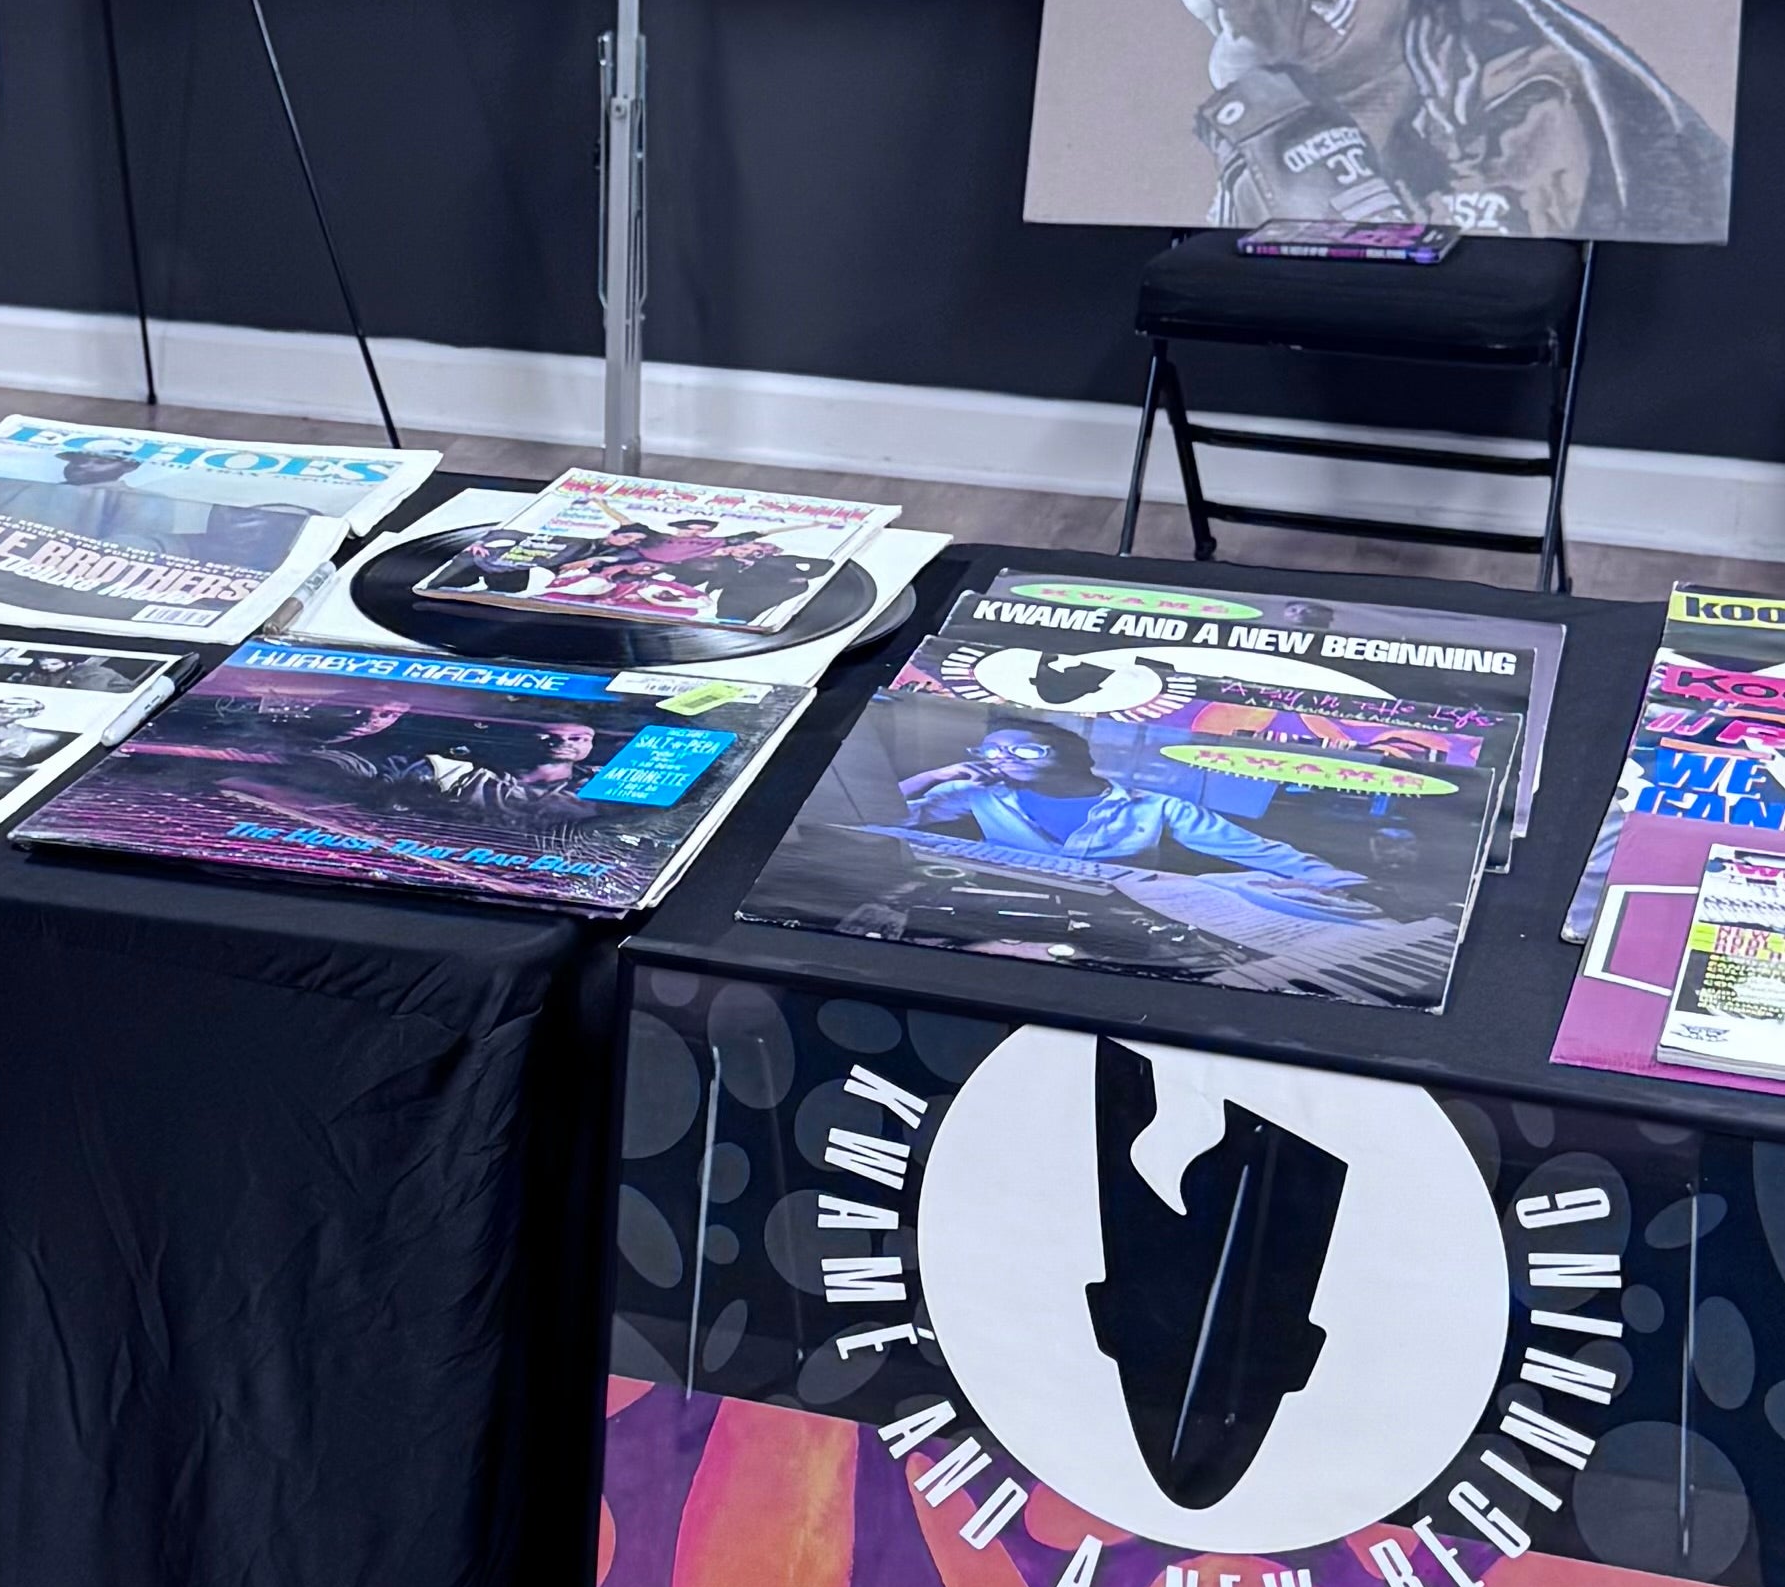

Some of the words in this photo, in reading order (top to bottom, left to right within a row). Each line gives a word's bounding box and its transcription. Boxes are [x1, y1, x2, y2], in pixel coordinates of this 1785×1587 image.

[6, 424, 404, 484] ECHOES
[30, 539, 264, 602] BROTHERS
[973, 600, 1112, 633] KWAMÉ
[1109, 614, 1189, 642] AND
[1192, 622, 1219, 645] A
[1228, 625, 1315, 655] NEW
[1320, 633, 1518, 676] BEGINNING
[402, 663, 571, 692] MACHINE
[601, 767, 692, 787] ANTOINETTE
[1655, 748, 1767, 800] WE
[816, 1064, 938, 1361] KWAMÉ
[877, 1400, 1029, 1551] AND
